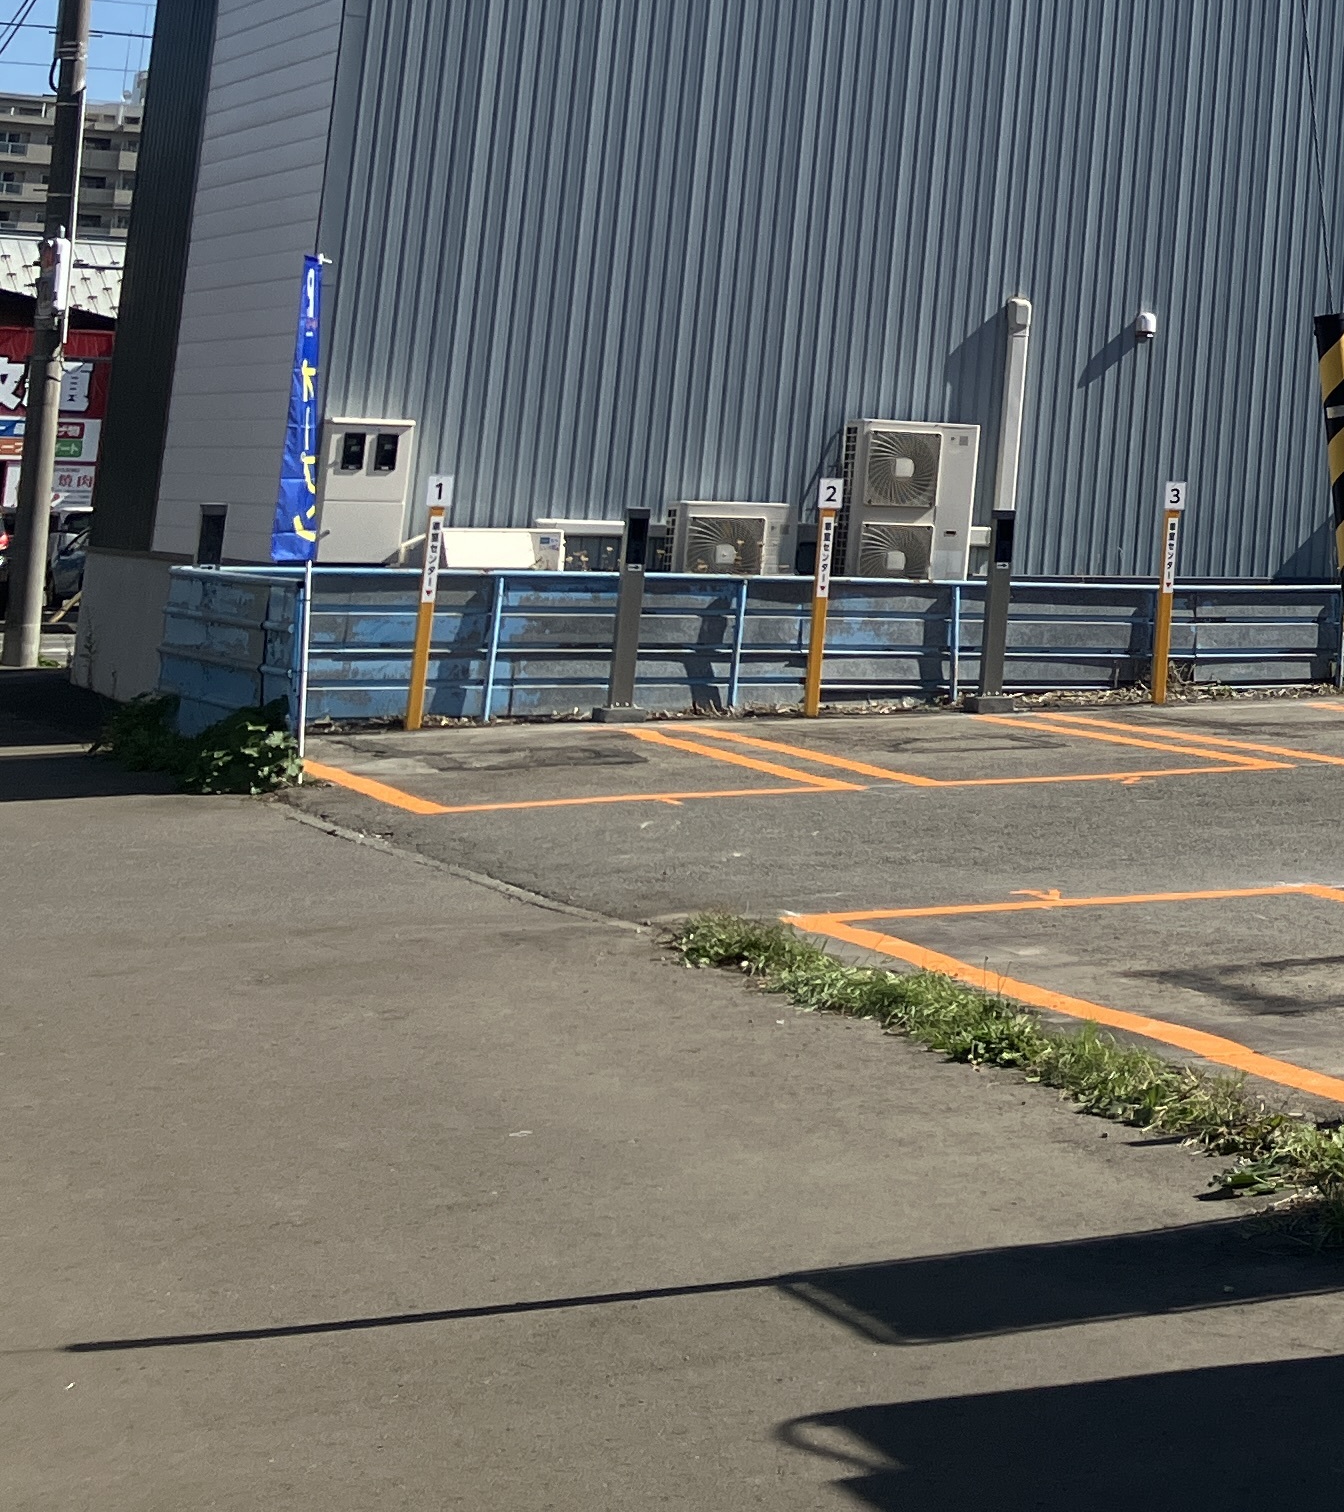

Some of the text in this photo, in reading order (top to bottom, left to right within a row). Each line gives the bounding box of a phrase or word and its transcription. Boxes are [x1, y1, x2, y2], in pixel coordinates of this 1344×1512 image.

[435, 482, 443, 500] 1
[824, 486, 837, 502] 2
[1169, 488, 1180, 504] 3
